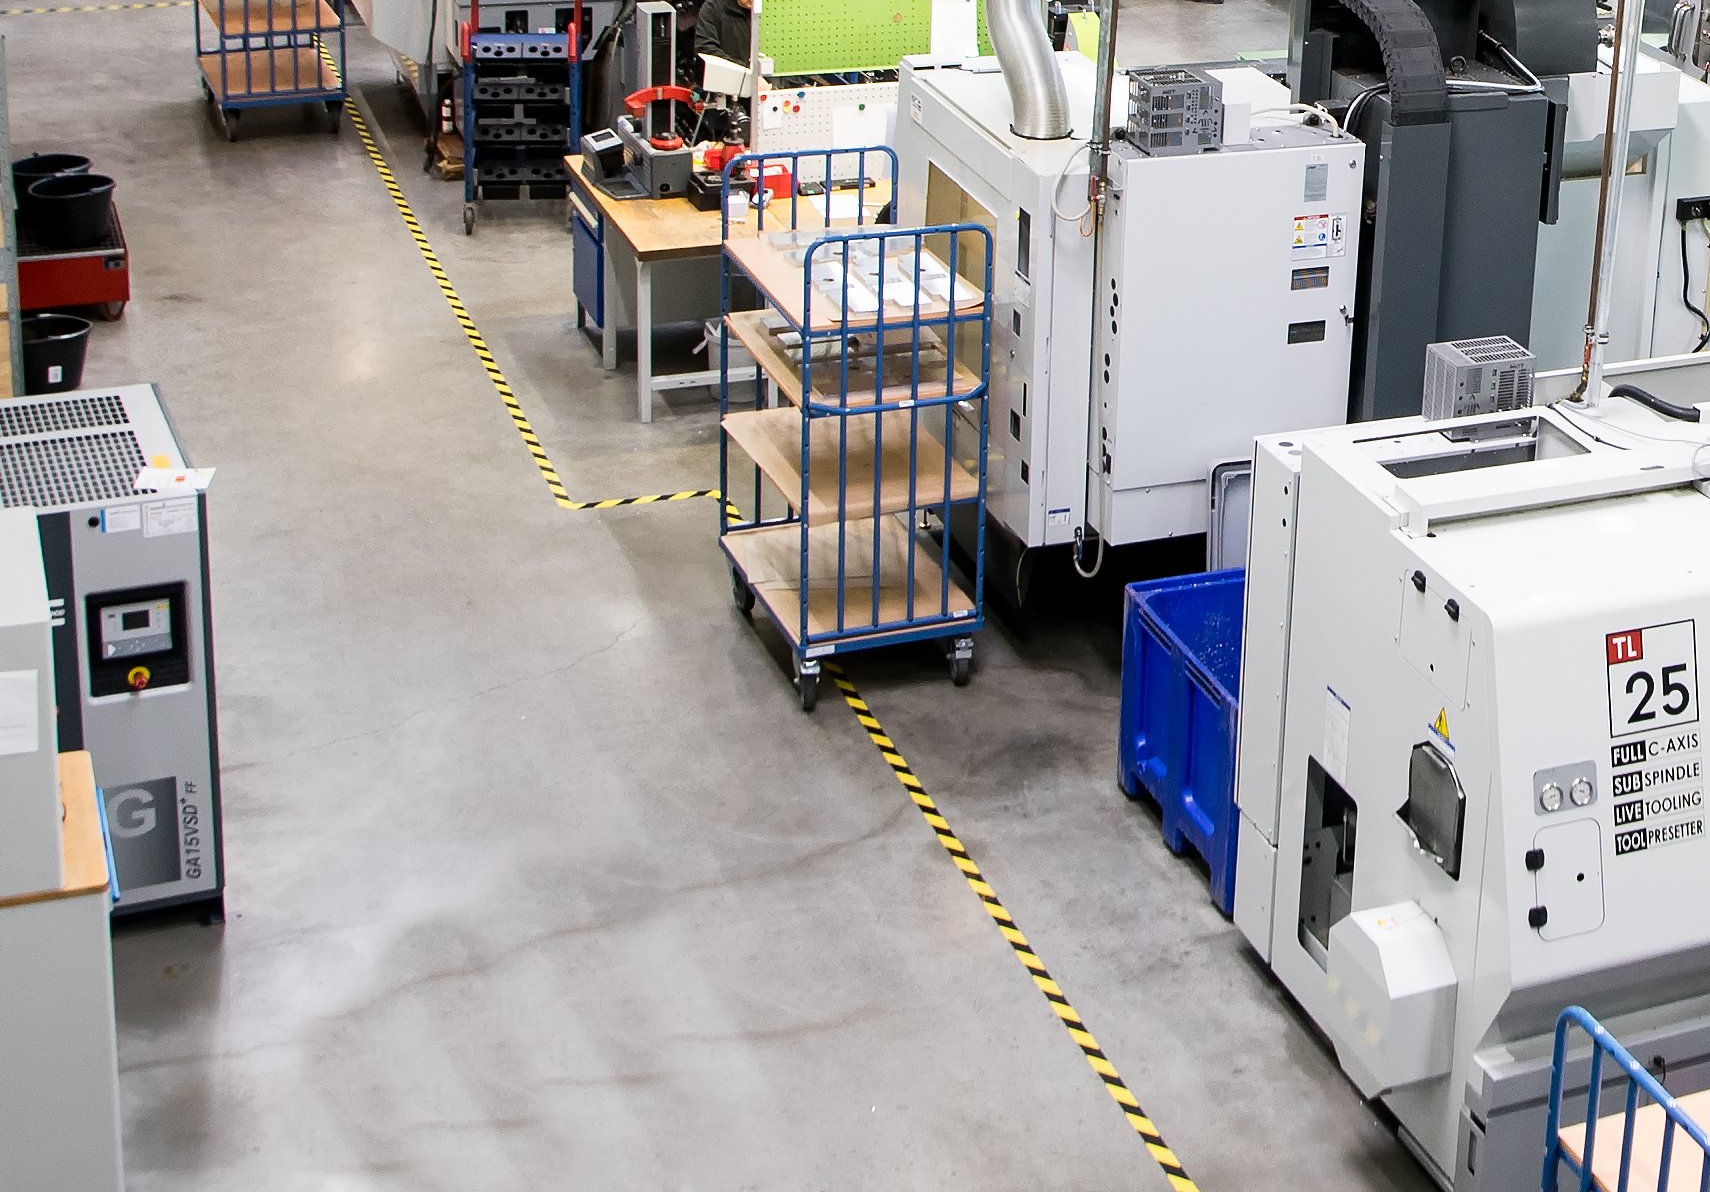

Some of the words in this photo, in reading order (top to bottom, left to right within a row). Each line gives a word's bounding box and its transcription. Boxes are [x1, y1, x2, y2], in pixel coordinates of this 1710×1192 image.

[1612, 635, 1638, 659] TL
[1625, 662, 1690, 724] 25
[1612, 743, 1645, 766] FULL
[1648, 733, 1699, 757] C-AXIS
[1614, 773, 1641, 795] SUB
[1644, 762, 1700, 787] SPINDLE
[107, 787, 157, 839] G
[1615, 802, 1643, 824] LIVE
[1645, 790, 1702, 816] TOOLING
[1616, 831, 1647, 853] TOOL
[1648, 819, 1704, 845] PRESETTER
